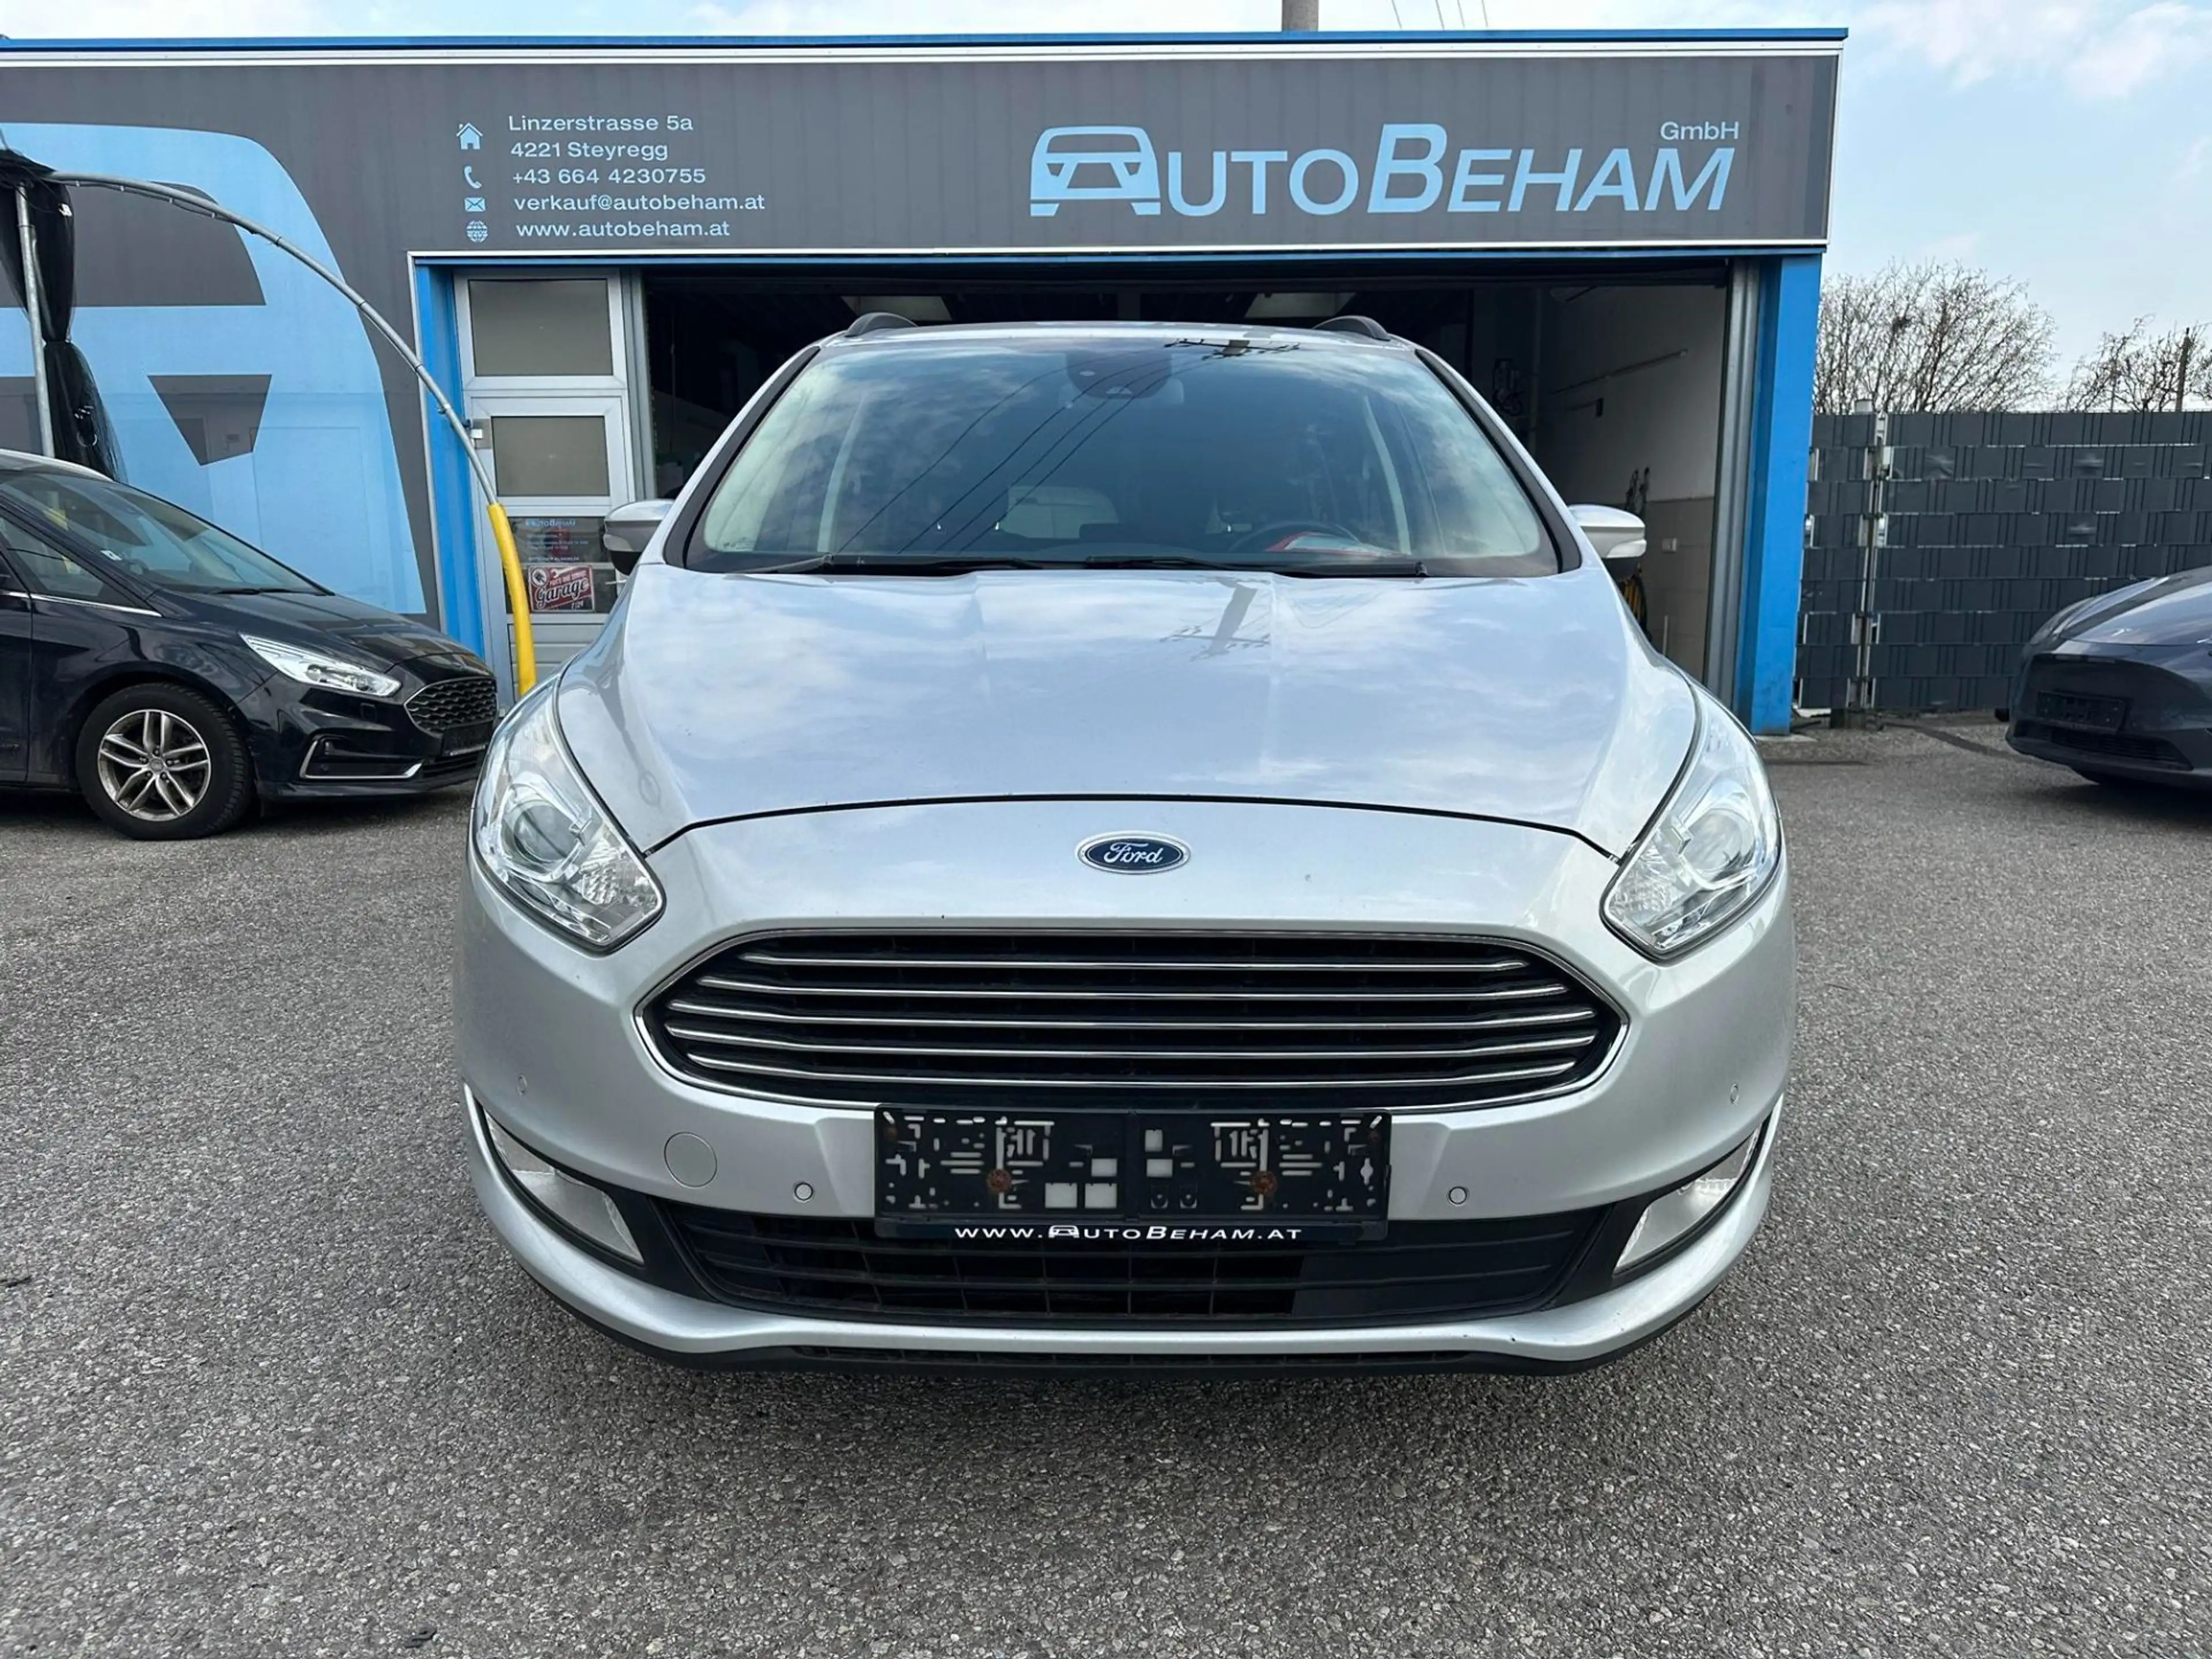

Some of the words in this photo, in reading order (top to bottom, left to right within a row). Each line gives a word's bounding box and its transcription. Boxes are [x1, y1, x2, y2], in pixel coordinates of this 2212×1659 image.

[509, 115, 658, 131] Linzerstrasse
[666, 115, 694, 131] 5a
[1660, 121, 1739, 141] GmbH
[510, 142, 560, 158] 4221
[567, 142, 668, 161] Steyregg
[513, 169, 551, 184] +43
[558, 168, 600, 184] 664
[608, 168, 706, 184] 4230755
[514, 194, 766, 211] verkauf@autobeham.at
[516, 221, 730, 237] www.autobeham.at
[535, 577, 590, 609] Garage
[1103, 842, 1164, 863] Ford
